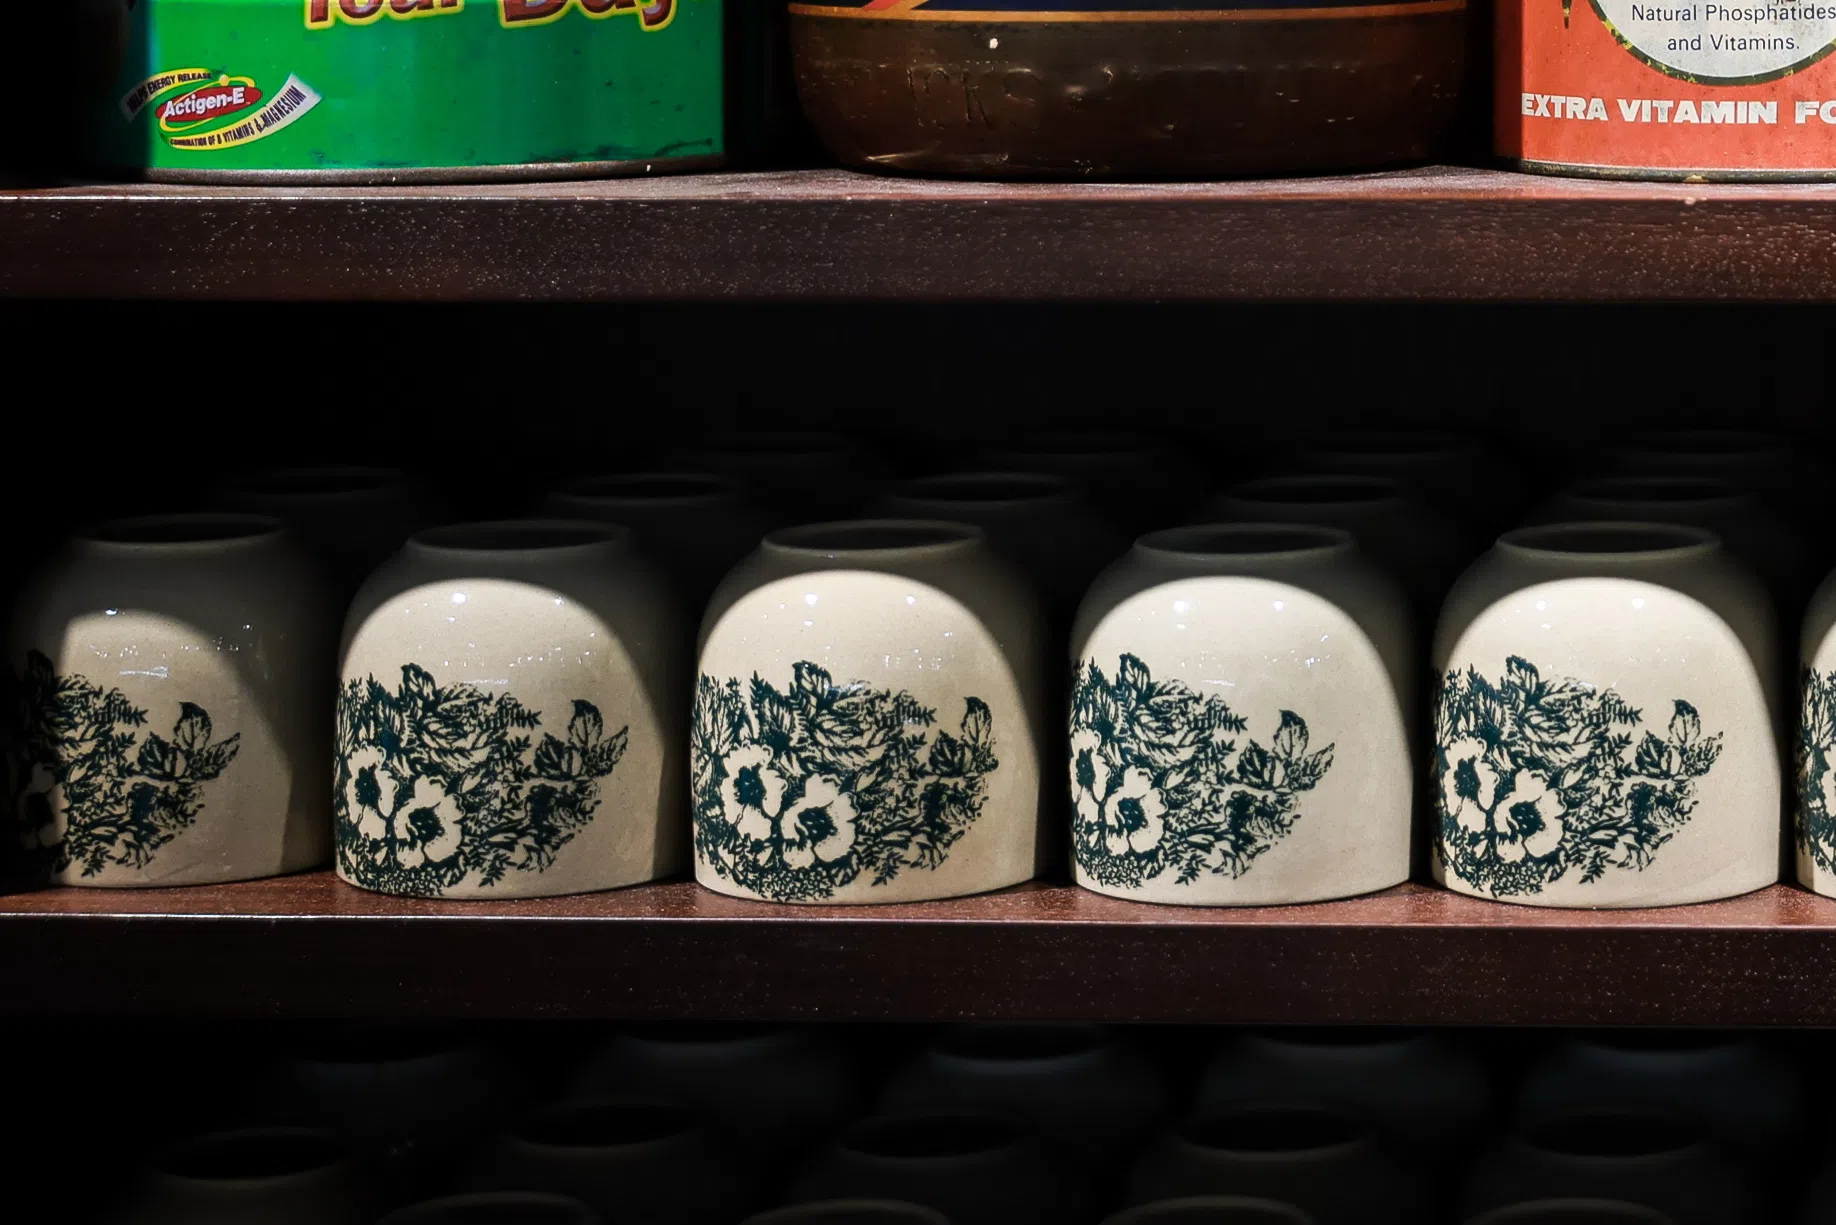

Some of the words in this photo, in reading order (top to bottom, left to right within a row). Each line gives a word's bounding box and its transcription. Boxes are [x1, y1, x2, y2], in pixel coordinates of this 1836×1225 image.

[1631, 3, 1698, 22] Natural
[1705, 3, 1836, 24] Phosphatides
[1667, 35, 1702, 52] and
[1710, 33, 1801, 51] Vitamins.
[147, 74, 176, 95] ENERGY
[164, 87, 245, 117] Actigen-E
[224, 122, 255, 143] VITAMINS
[260, 84, 308, 129] MAGNESIUM
[1521, 92, 1609, 122] EXTRA
[1616, 99, 1778, 125] VITAMIN
